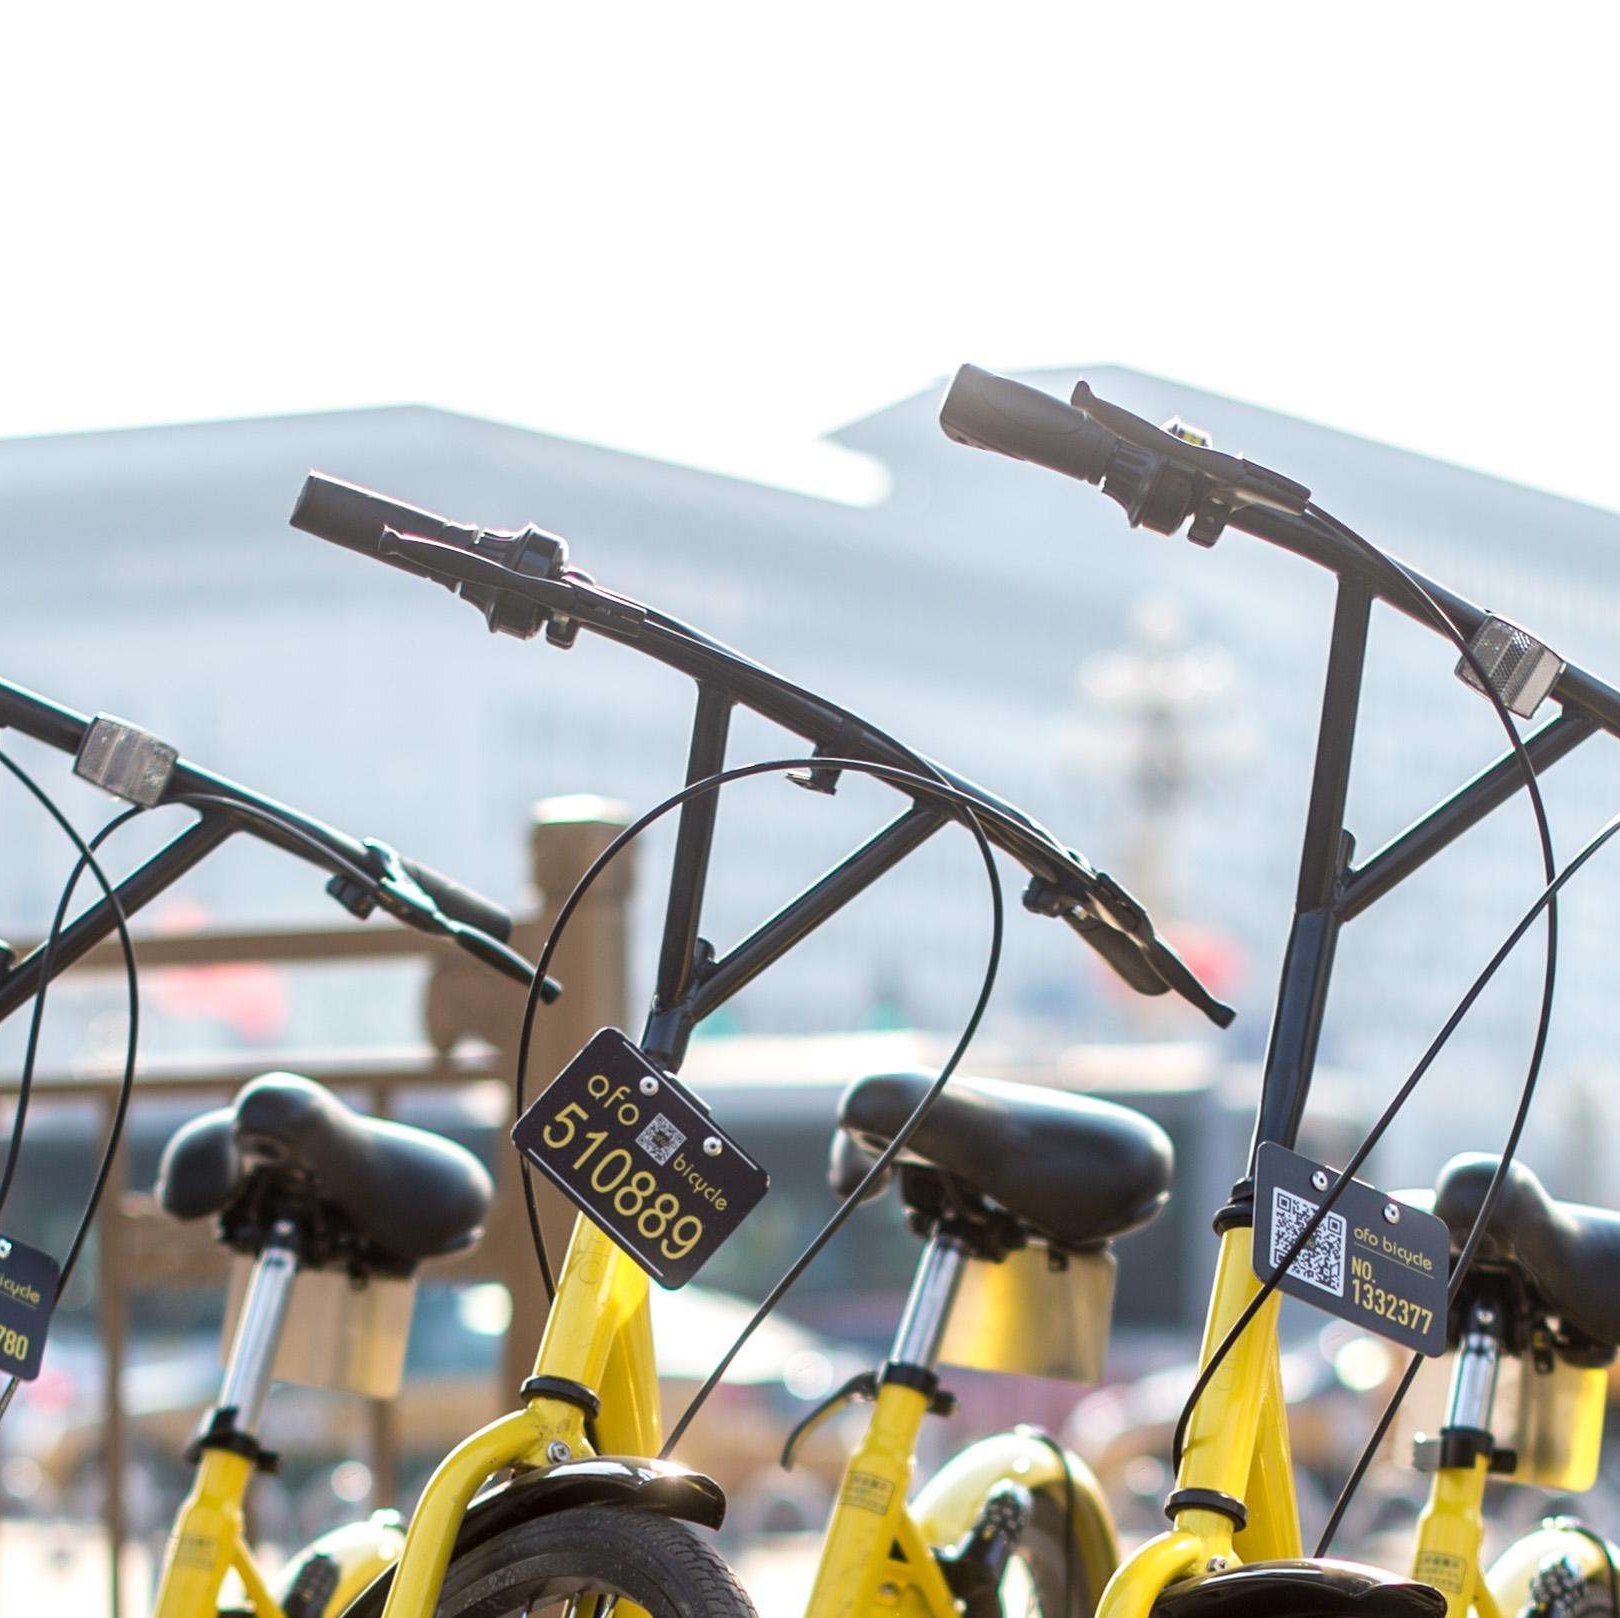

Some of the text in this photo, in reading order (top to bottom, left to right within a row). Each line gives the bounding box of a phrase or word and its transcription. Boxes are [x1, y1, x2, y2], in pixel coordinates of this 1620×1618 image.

[587, 1074, 728, 1211] ofo bicycle
[542, 1102, 703, 1260] 510889
[1351, 1255, 1376, 1284] NO.
[1354, 1226, 1433, 1271] ofo bicycle
[1351, 1279, 1434, 1335] 1332377
